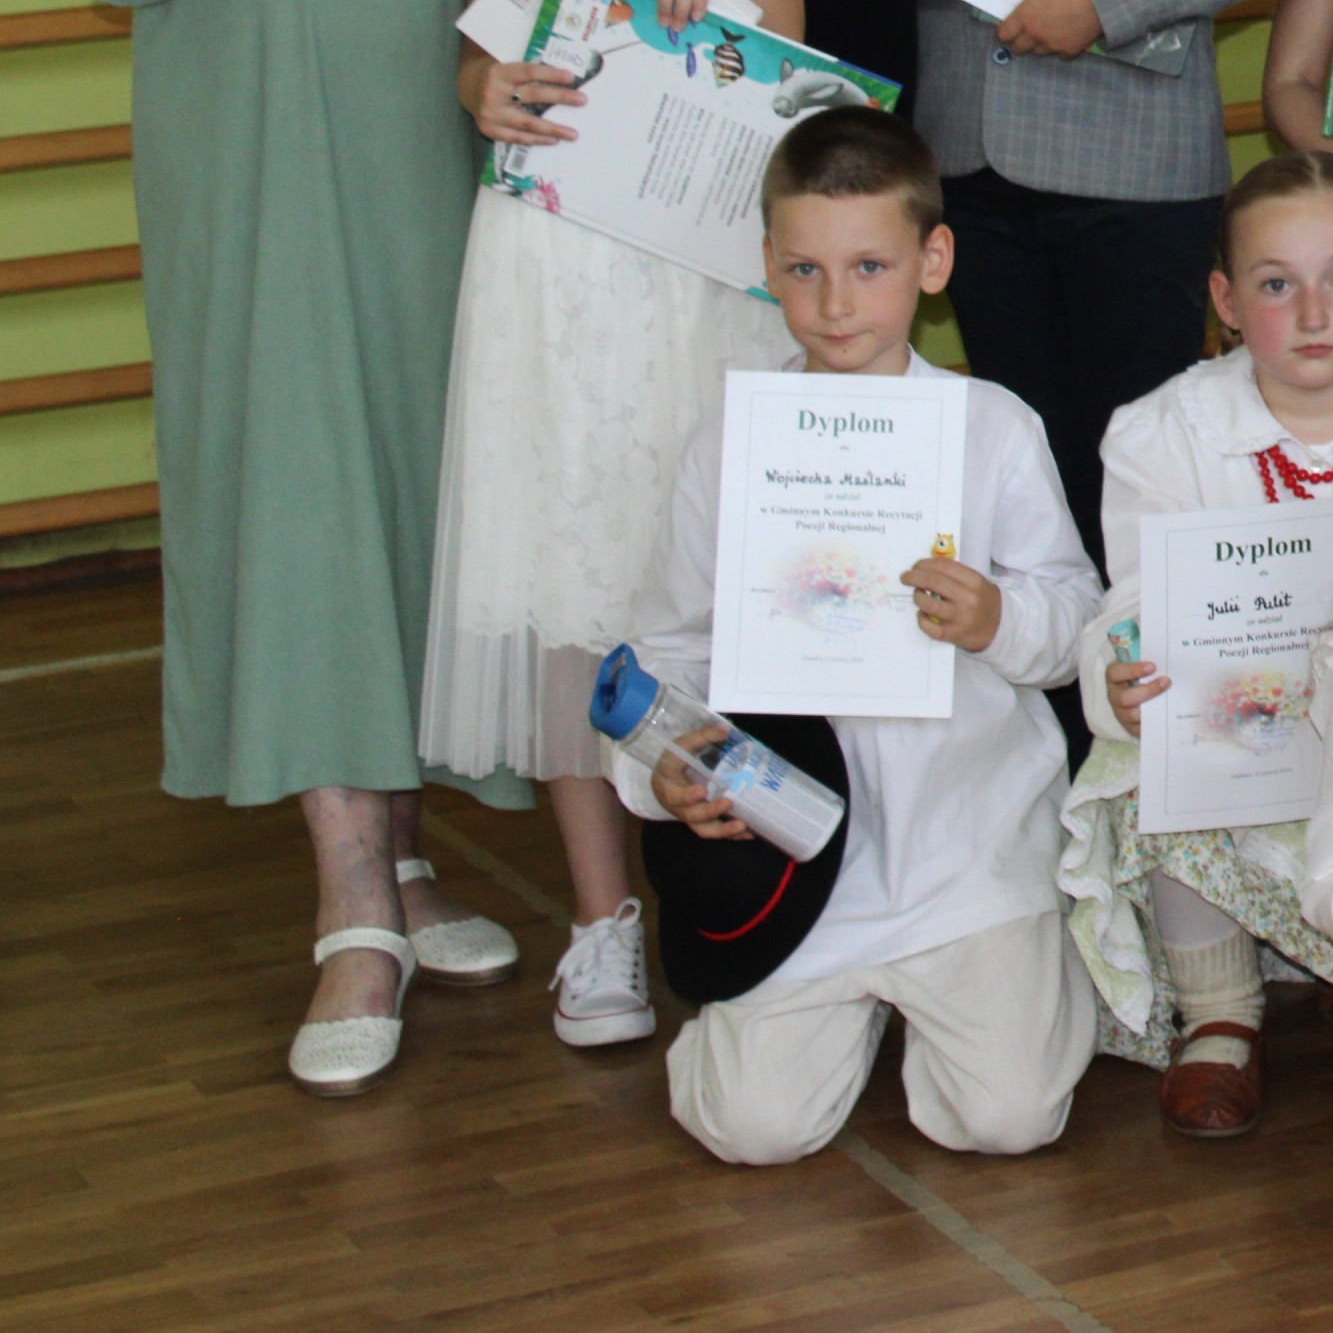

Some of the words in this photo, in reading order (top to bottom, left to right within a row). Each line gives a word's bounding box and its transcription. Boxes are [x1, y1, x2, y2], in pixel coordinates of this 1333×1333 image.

[798, 410, 893, 438] Dyplom
[1216, 537, 1311, 566] Dyplom
[1207, 596, 1240, 621] Julii
